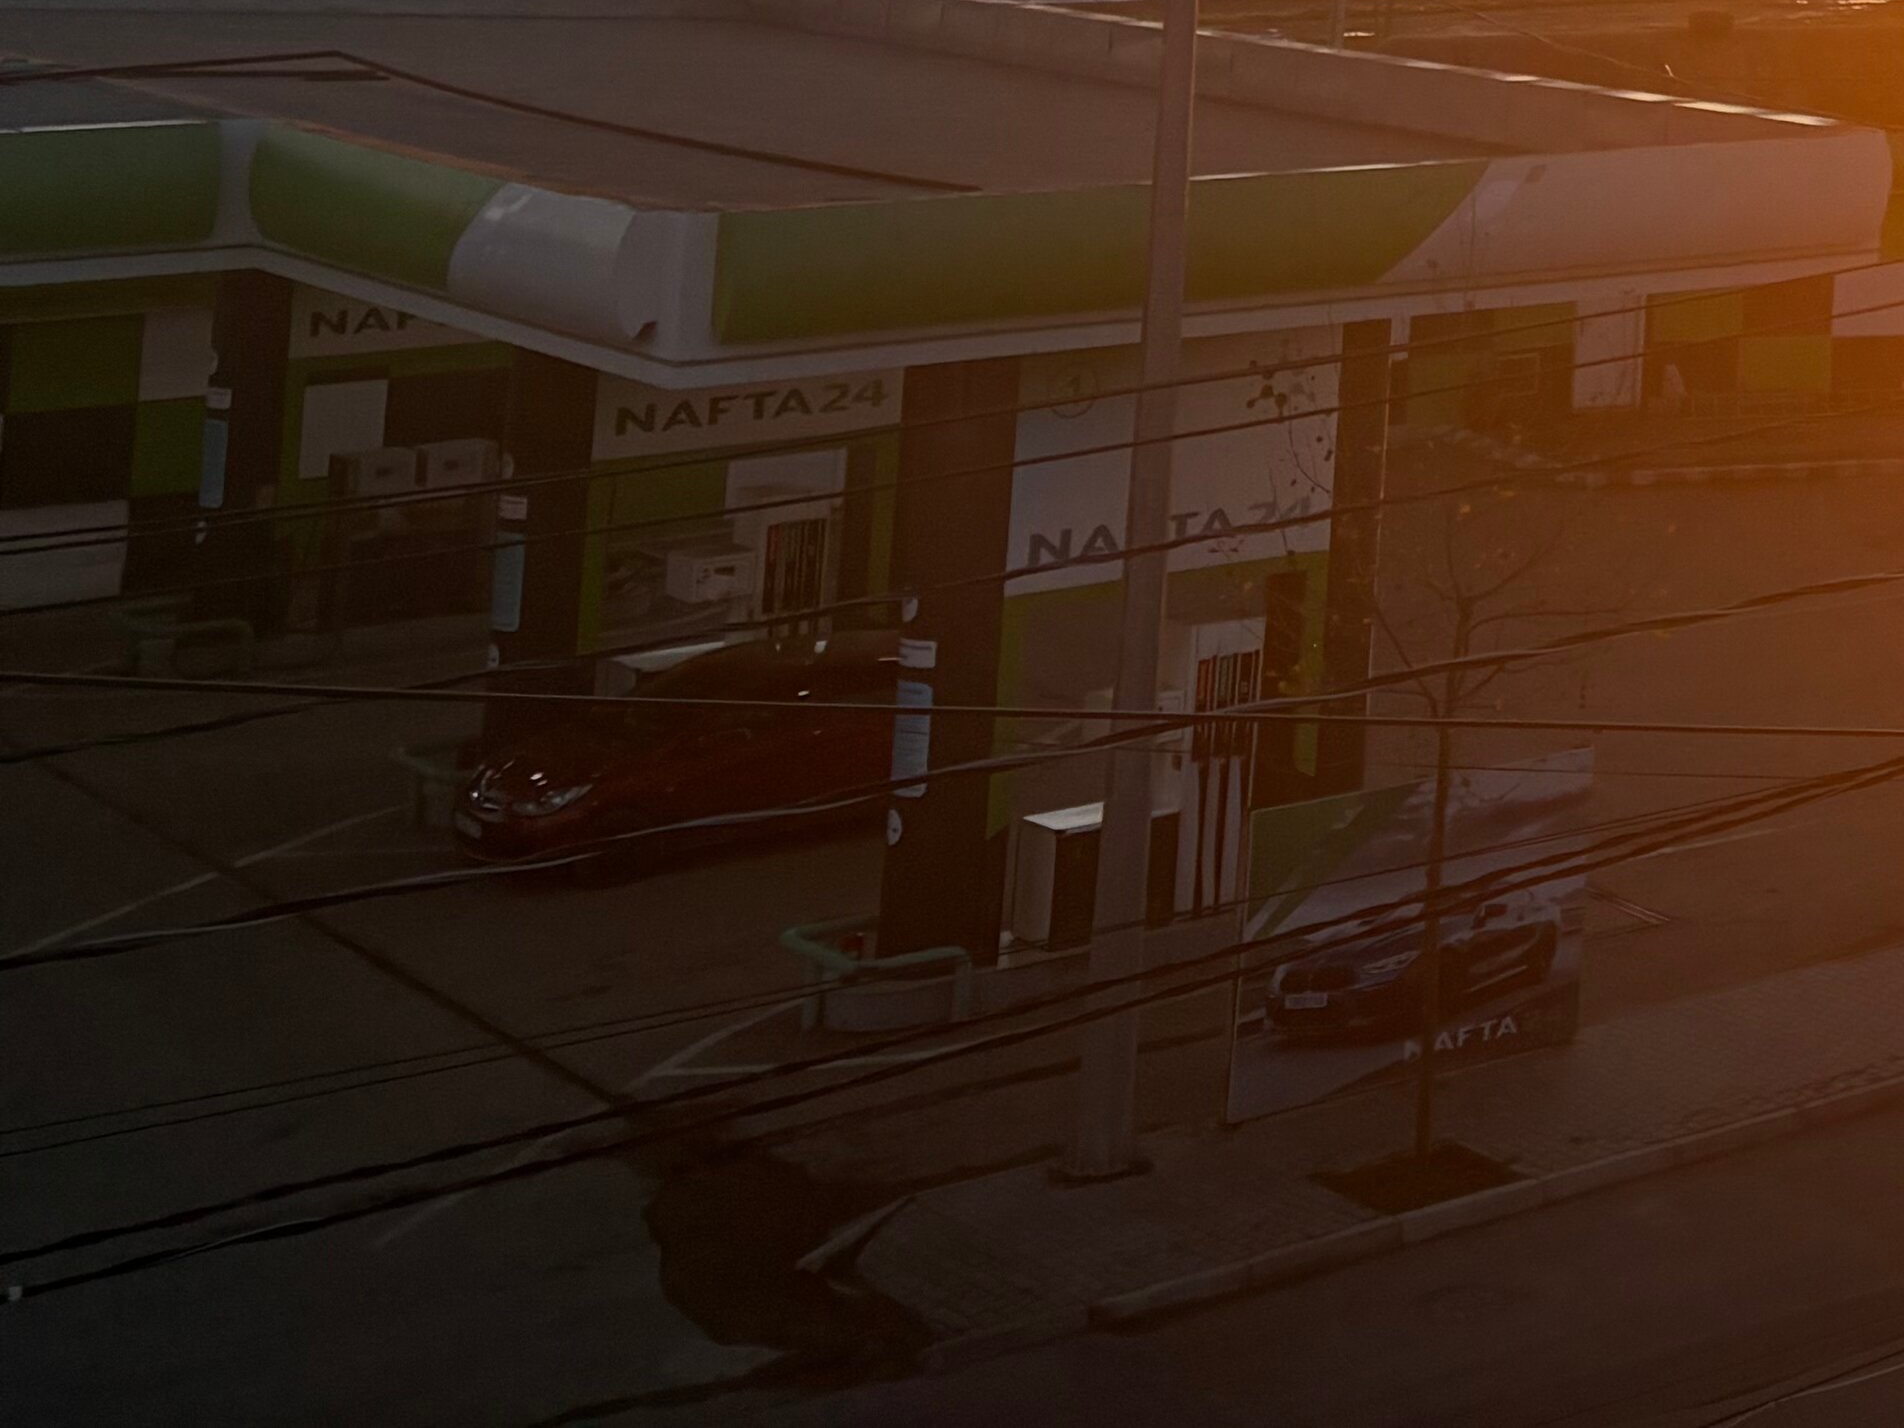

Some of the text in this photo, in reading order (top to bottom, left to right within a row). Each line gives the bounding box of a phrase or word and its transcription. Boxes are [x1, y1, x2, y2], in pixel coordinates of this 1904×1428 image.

[310, 305, 448, 337] NAF
[615, 378, 888, 436] NAFTA24
[1029, 495, 1311, 566] NATA24
